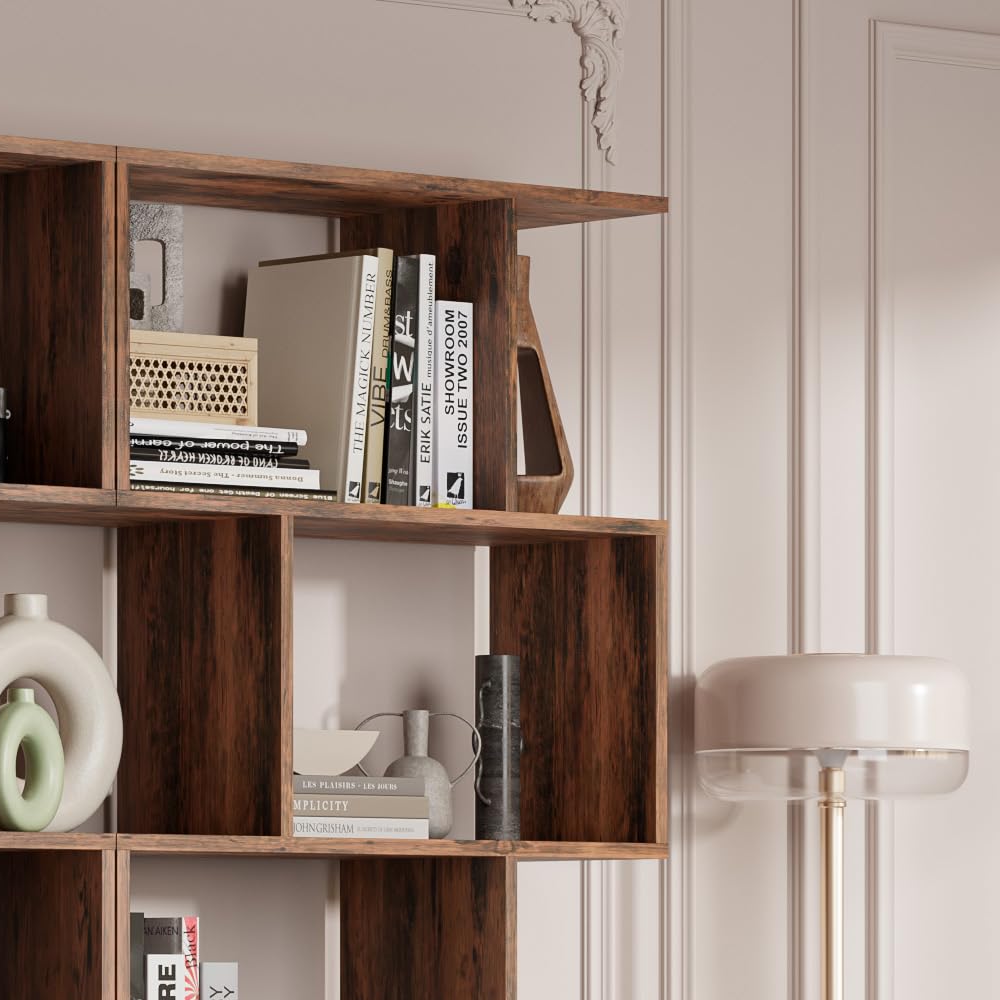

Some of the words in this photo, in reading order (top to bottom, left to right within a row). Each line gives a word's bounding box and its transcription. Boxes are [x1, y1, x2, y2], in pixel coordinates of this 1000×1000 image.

[361, 273, 376, 344] NUMBER
[424, 262, 435, 336] d'ameublement
[457, 310, 468, 349] 2007
[370, 366, 387, 427] VIBE
[381, 269, 393, 359] DRUM&BASS
[425, 339, 435, 378] musique
[444, 309, 455, 415] SHOWROOM
[356, 350, 370, 416] MAGICK
[457, 353, 468, 397] TWO
[421, 383, 433, 424] SATIE
[457, 398, 468, 449] ISSUE
[130, 438, 172, 449] earni
[174, 440, 195, 451] of
[199, 440, 250, 452] power
[254, 443, 285, 454] The
[352, 421, 364, 454] THE
[419, 429, 431, 464] ERIK
[159, 467, 182, 477] Story
[183, 470, 211, 478] Secret
[213, 471, 229, 479] The
[237, 472, 272, 481] Summer
[275, 474, 304, 482] Donna
[235, 490, 261, 498] Death
[279, 492, 309, 500] Screen
[319, 781, 356, 789] PLAISIRS
[363, 782, 376, 790] LES
[293, 799, 349, 811] MPLICITY
[183, 925, 198, 969] Black
